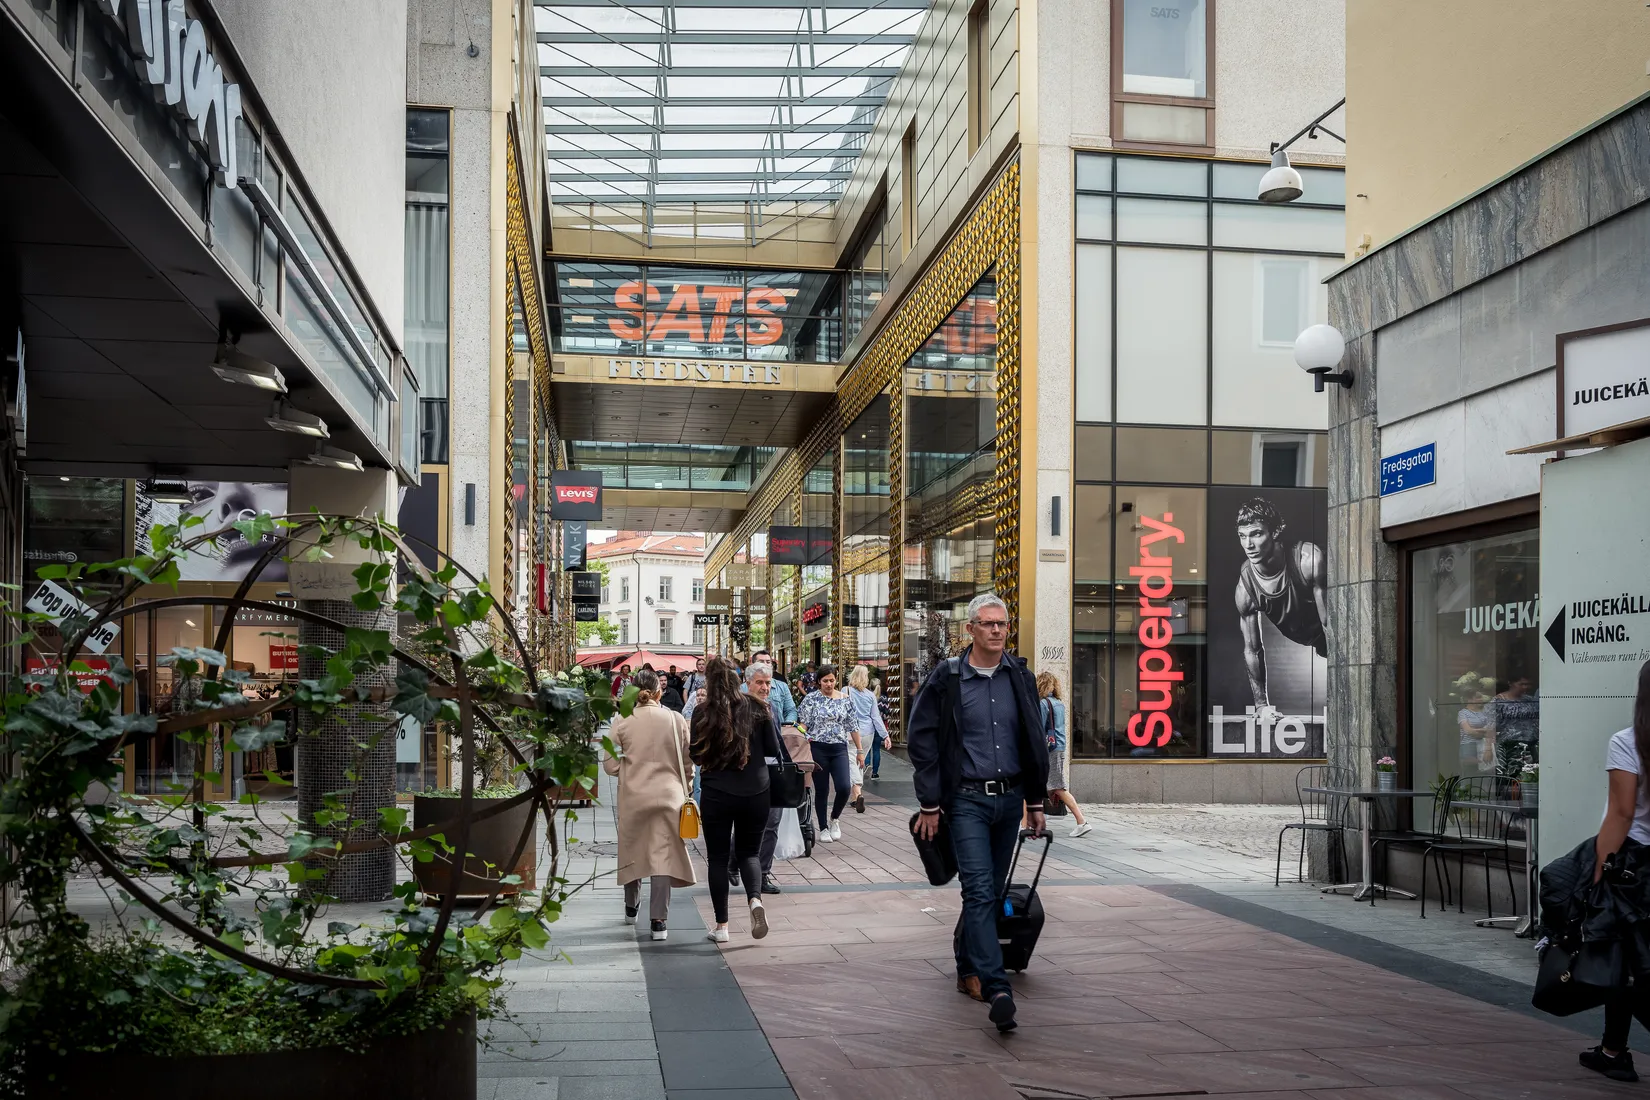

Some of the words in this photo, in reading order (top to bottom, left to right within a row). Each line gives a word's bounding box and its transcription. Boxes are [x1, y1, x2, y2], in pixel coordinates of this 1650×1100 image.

[1150, 7, 1179, 19] SATS
[608, 281, 788, 345] SATS
[608, 360, 781, 384] FREDSTAN
[1573, 377, 1649, 406] JUICEKÄ
[1382, 451, 1433, 475] Fredsgatan
[1382, 478, 1388, 492] 7
[1397, 474, 1404, 488] 5
[33, 584, 64, 613] Pop
[1571, 593, 1650, 619] JUICEKÄLL
[1127, 512, 1185, 747] Superdry.
[1571, 620, 1630, 645] INGÅNG.
[1571, 651, 1617, 664] Välkommen
[1618, 652, 1637, 662] runt
[1212, 705, 1307, 754] Life
